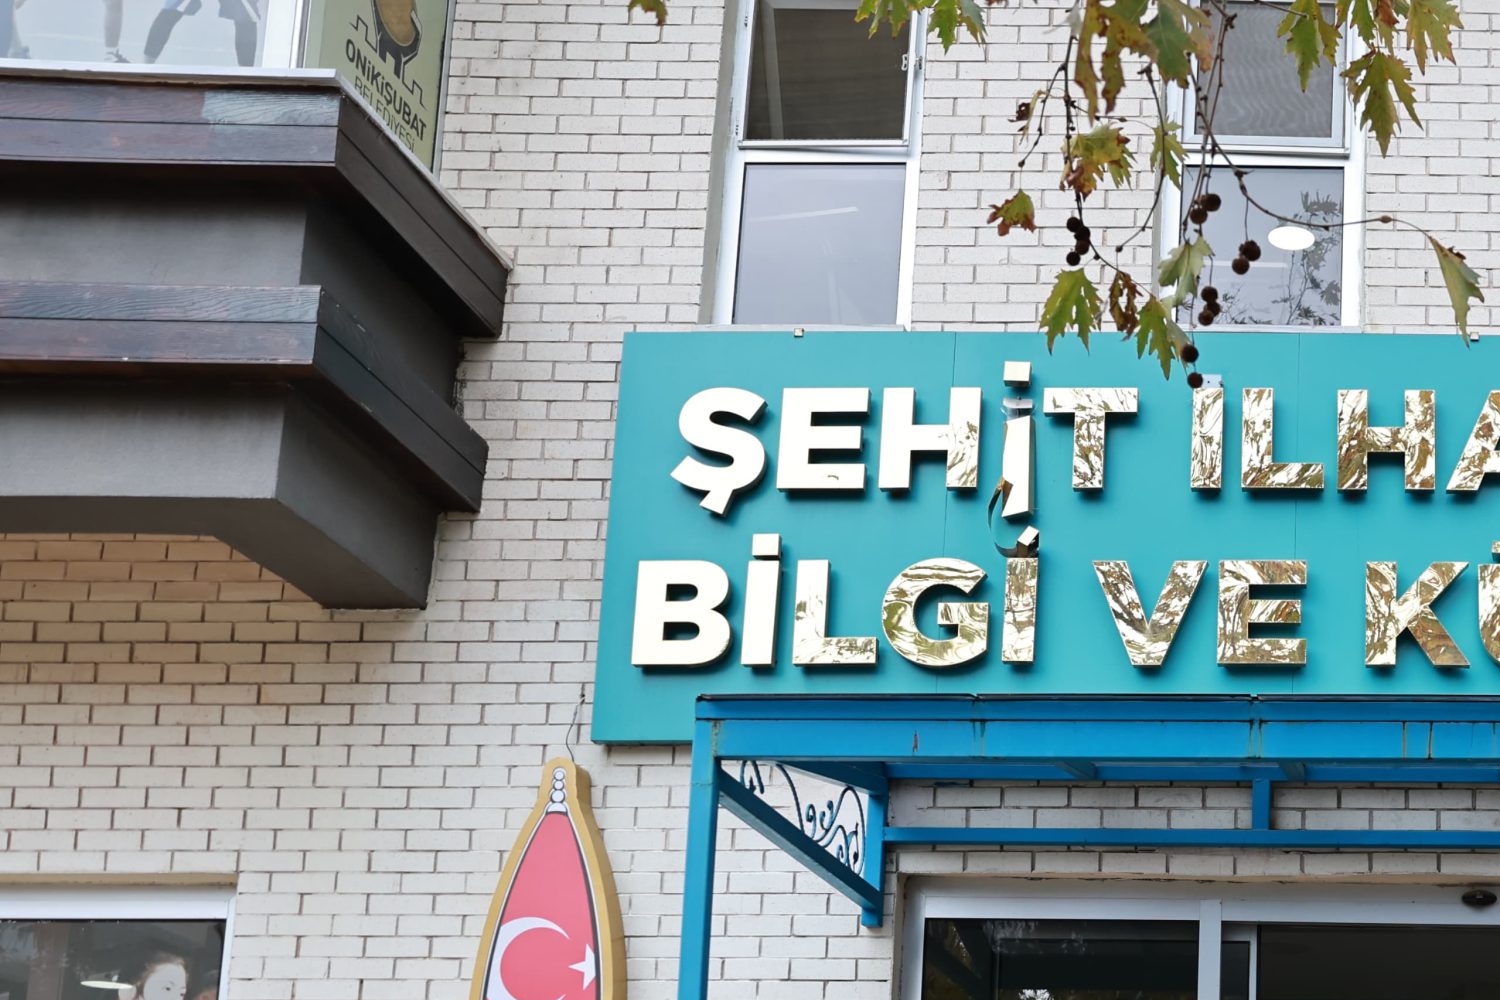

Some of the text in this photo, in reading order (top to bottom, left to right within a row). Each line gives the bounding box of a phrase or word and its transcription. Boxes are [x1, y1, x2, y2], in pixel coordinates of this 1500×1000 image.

[670, 360, 1139, 518] ŞEHİT
[631, 526, 1040, 669] BİLGİ
[1092, 559, 1308, 668] VE
